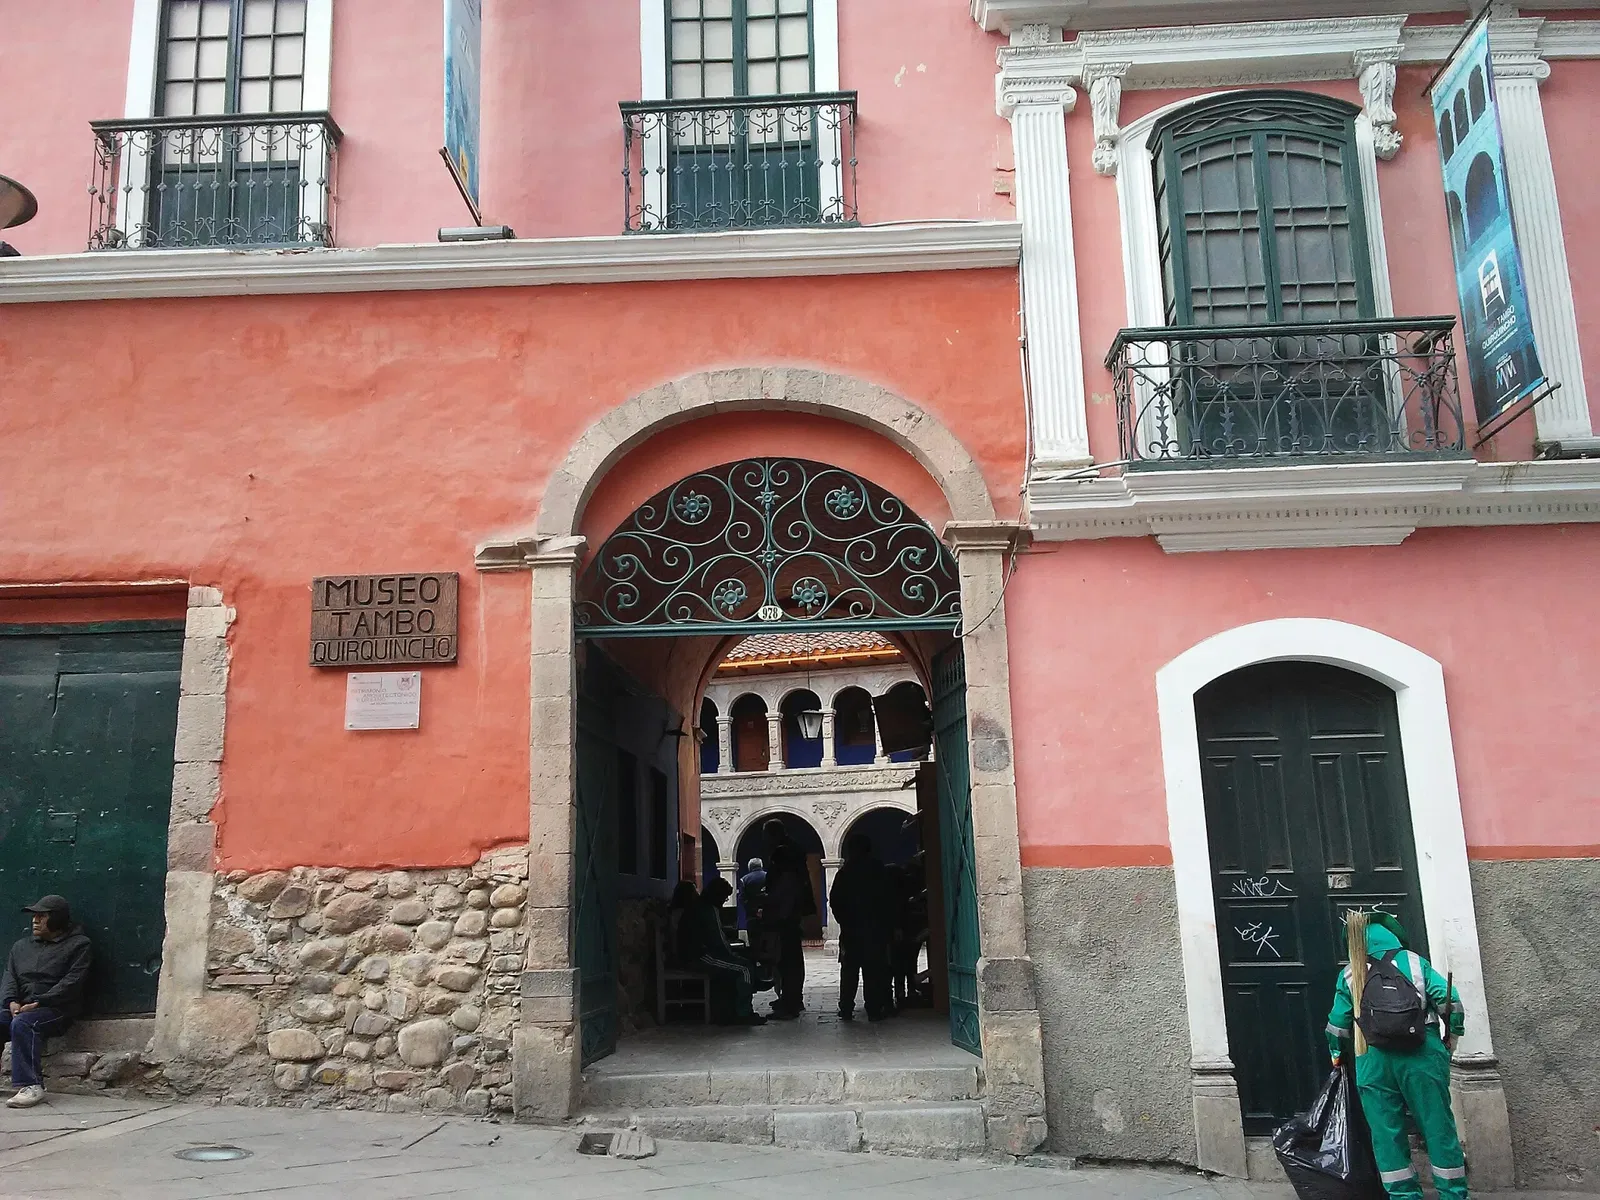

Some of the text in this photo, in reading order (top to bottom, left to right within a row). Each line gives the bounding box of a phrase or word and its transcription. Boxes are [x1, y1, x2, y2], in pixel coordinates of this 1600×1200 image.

[1497, 305, 1515, 324] TAMBO
[1482, 315, 1516, 350] QUIRQUINCHO
[325, 576, 441, 607] MUSEO
[332, 609, 435, 637] TAMBO
[762, 607, 779, 619] 978
[313, 637, 451, 663] QUIRQUINCHO
